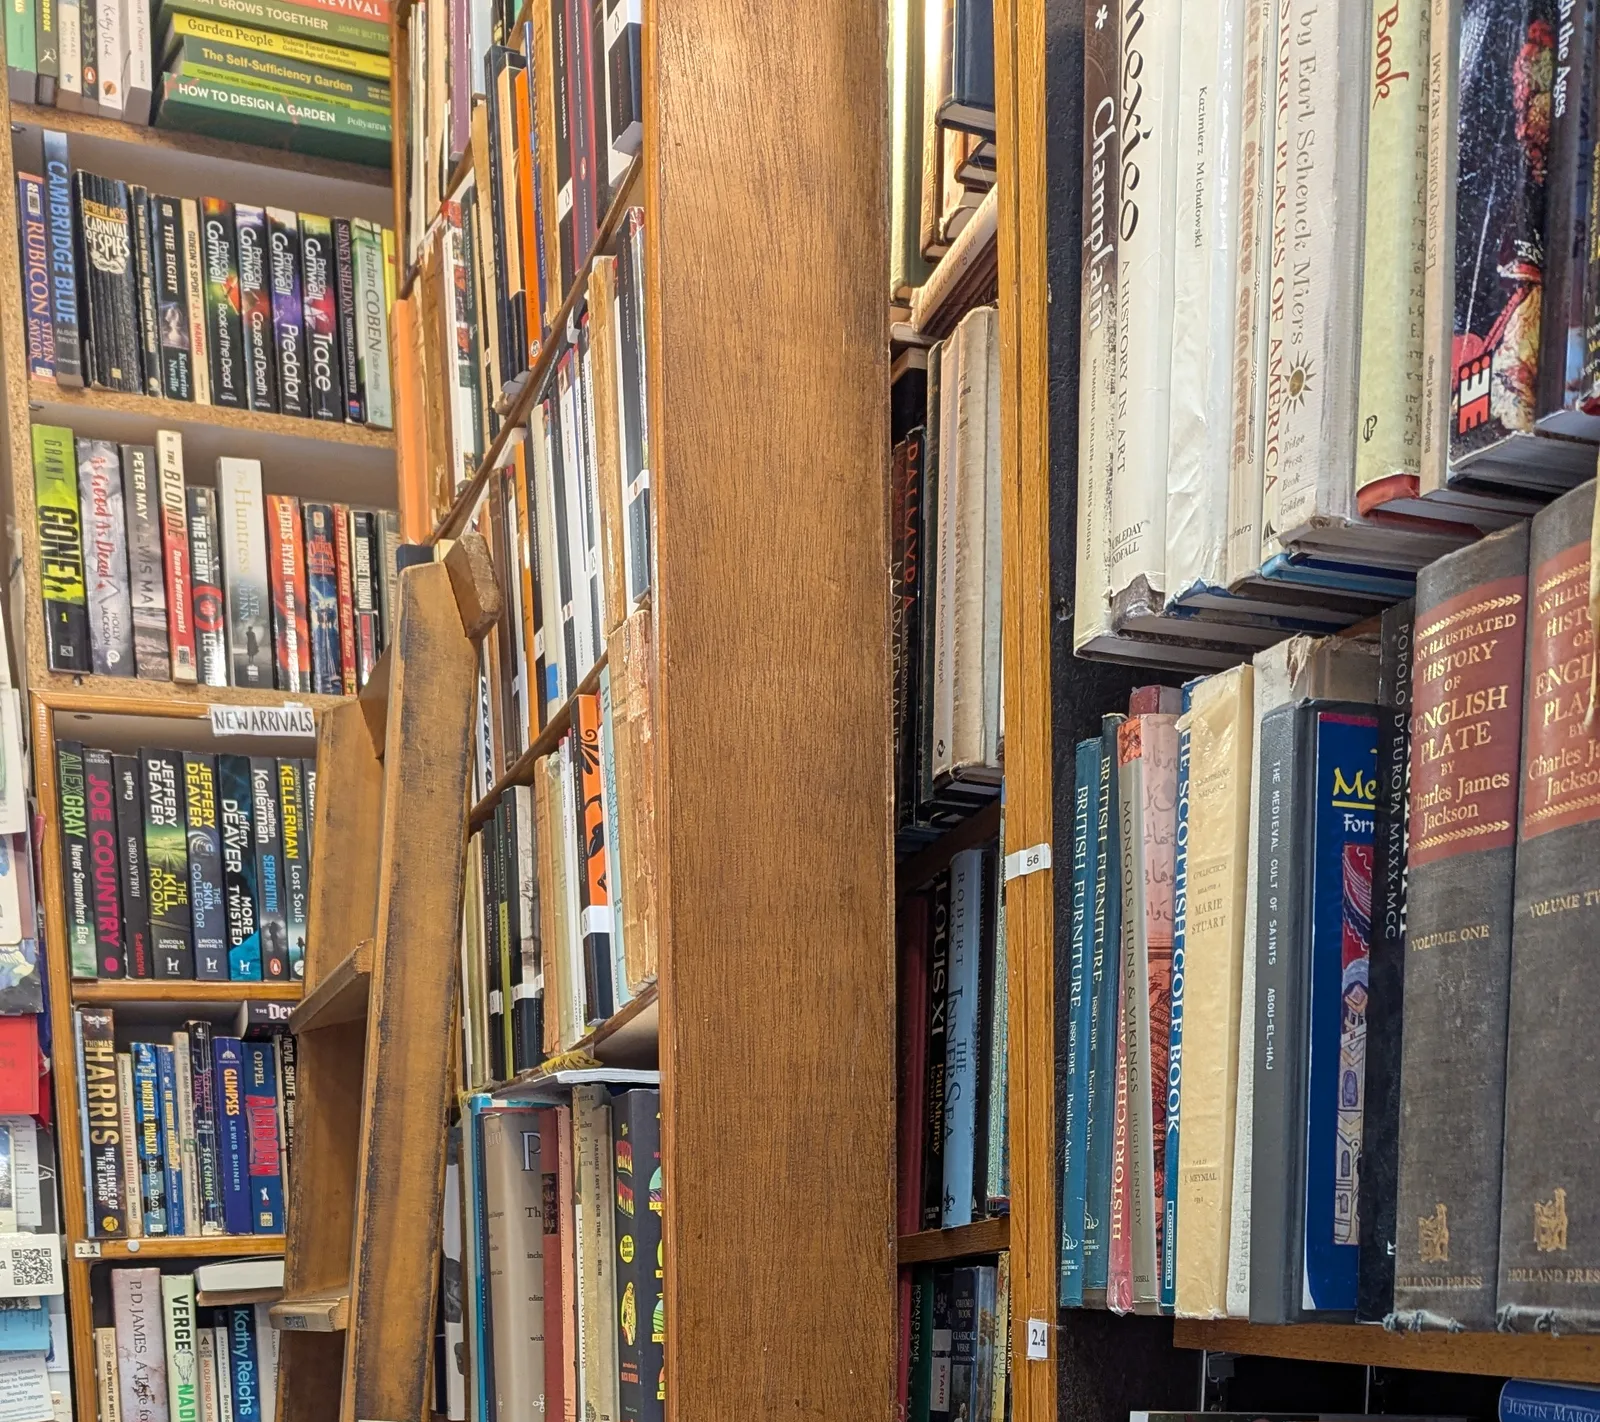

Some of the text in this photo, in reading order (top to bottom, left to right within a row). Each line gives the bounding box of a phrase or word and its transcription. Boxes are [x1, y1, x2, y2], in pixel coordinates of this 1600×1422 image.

[187, 18, 274, 47] Garden People
[202, 48, 353, 93] The Garden
[178, 82, 337, 124] HOW TO DESIGN A GARDEN
[1196, 85, 1209, 157] Kazimierz
[1273, 139, 1288, 270] PLACES
[1291, 8, 1319, 346] by Earl Schenck Miers
[46, 160, 76, 325] CAMBRIDGE BLUE
[85, 215, 129, 240] CARNIVAL
[1083, 95, 1117, 333] Champlain
[25, 219, 50, 319] RUBICON
[162, 223, 180, 295] THE EIGHT
[365, 289, 382, 353] COBEN
[1271, 275, 1286, 324] OF
[281, 323, 300, 402] Predator
[312, 332, 333, 393] Trace
[1116, 282, 1131, 474] HISTORY IN ART
[1264, 338, 1284, 495] AMERICA
[131, 451, 149, 519] PETER MAY
[191, 515, 209, 583] THE ENEMY
[278, 503, 296, 576] CHRIS RYAN
[1422, 638, 1499, 686] HISTORY
[1428, 612, 1517, 657] ILLUSTRATED
[1413, 685, 1509, 740] ENGLISH
[1443, 674, 1462, 695] OF
[213, 708, 315, 734] NEW ARRIVALS
[1419, 720, 1493, 768] PLATE
[147, 758, 165, 826] DEAVER
[161, 759, 177, 828] JEFFERY
[185, 762, 203, 828] DEAVER
[200, 762, 216, 829] JEFFERY
[1440, 760, 1456, 777] BY
[1455, 767, 1511, 803] James
[222, 799, 242, 874] DEAVER
[253, 769, 270, 844] Kellerman
[280, 764, 299, 860] KELLERMAN
[1421, 801, 1480, 838] Jackson
[87, 774, 120, 949] JOE COUNTRY
[1026, 852, 1040, 867] 56
[1090, 755, 1112, 983] BRITISH FURNITURE
[150, 867, 166, 917] ROOM
[163, 873, 178, 911] KILL
[191, 862, 206, 929] COLLECTOR
[202, 880, 214, 910] SKIN
[228, 885, 244, 947] TWISTED
[240, 896, 254, 936] MORE
[1069, 784, 1090, 1008] BRITISH FURNITURE
[1193, 897, 1224, 917] MARIE
[1264, 759, 1282, 1071] THE MEDIEVAL CULT OF SAINTS ABOU-EL-HAJ
[77, 924, 90, 946] Else
[929, 884, 949, 995] LOUIS
[1191, 914, 1227, 936] STUART
[1411, 922, 1490, 953] VOLUME ONE
[1167, 779, 1190, 1136] SCOTTISH GOLF BOOK
[1125, 918, 1140, 1094] HUNS VIKINGS
[84, 1044, 120, 1146] HARRIS
[253, 1050, 266, 1088] OPPEL
[223, 1067, 241, 1192] GLIMPSES SHINER
[1111, 1055, 1128, 1241] HISTORISCHER
[105, 1162, 117, 1198] SILENCE
[78, 1244, 99, 1255] 2.2
[130, 1308, 148, 1353] JAMES
[171, 1294, 192, 1351] VERGE
[1031, 1328, 1048, 1348] 2.4
[232, 1309, 254, 1417] Kathy Reichs
[1506, 1398, 1548, 1420] JUSTIN
